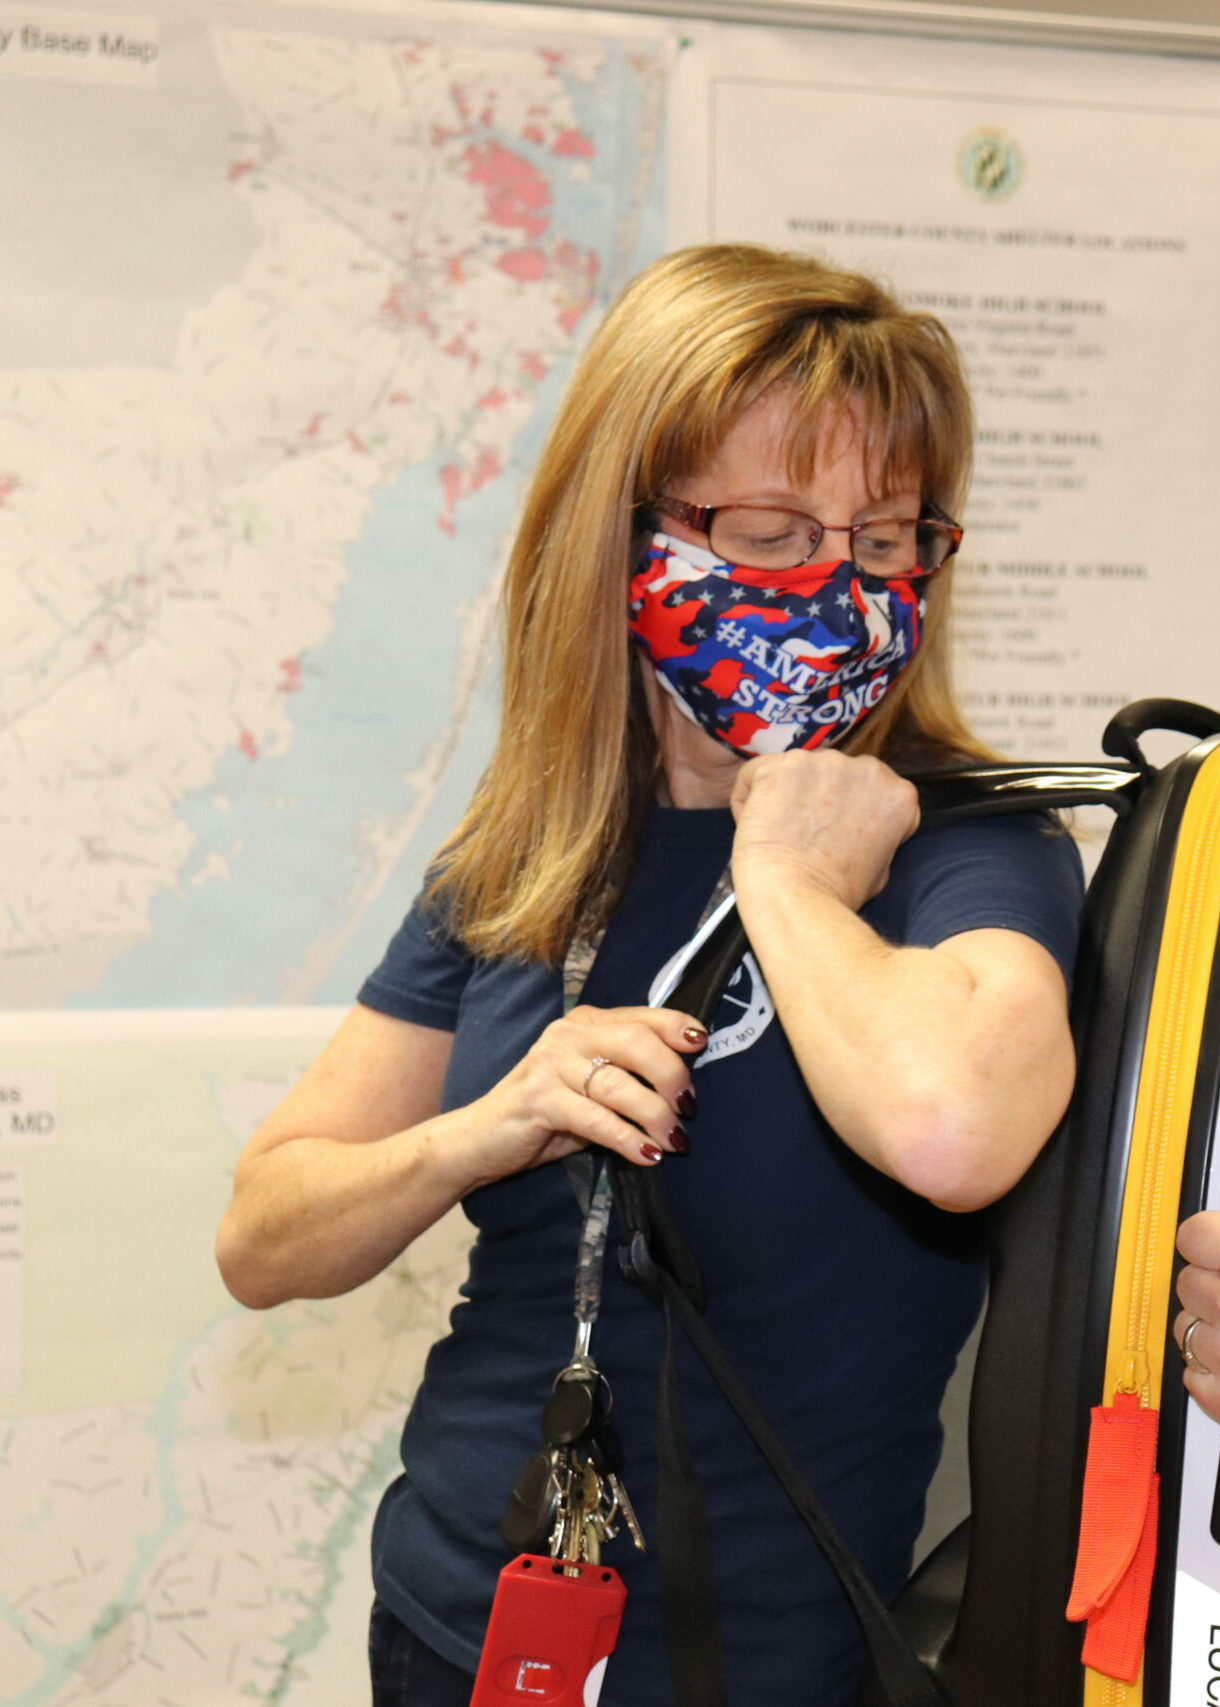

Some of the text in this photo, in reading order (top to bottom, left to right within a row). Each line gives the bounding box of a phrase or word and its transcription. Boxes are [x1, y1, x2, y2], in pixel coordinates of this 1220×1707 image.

[20, 26, 92, 56] Base
[97, 33, 160, 63] Map
[716, 620, 906, 695] #AMERICA
[733, 674, 889, 725] STRONG
[736, 1026, 756, 1043] MD
[11, 1112, 56, 1136] MD
